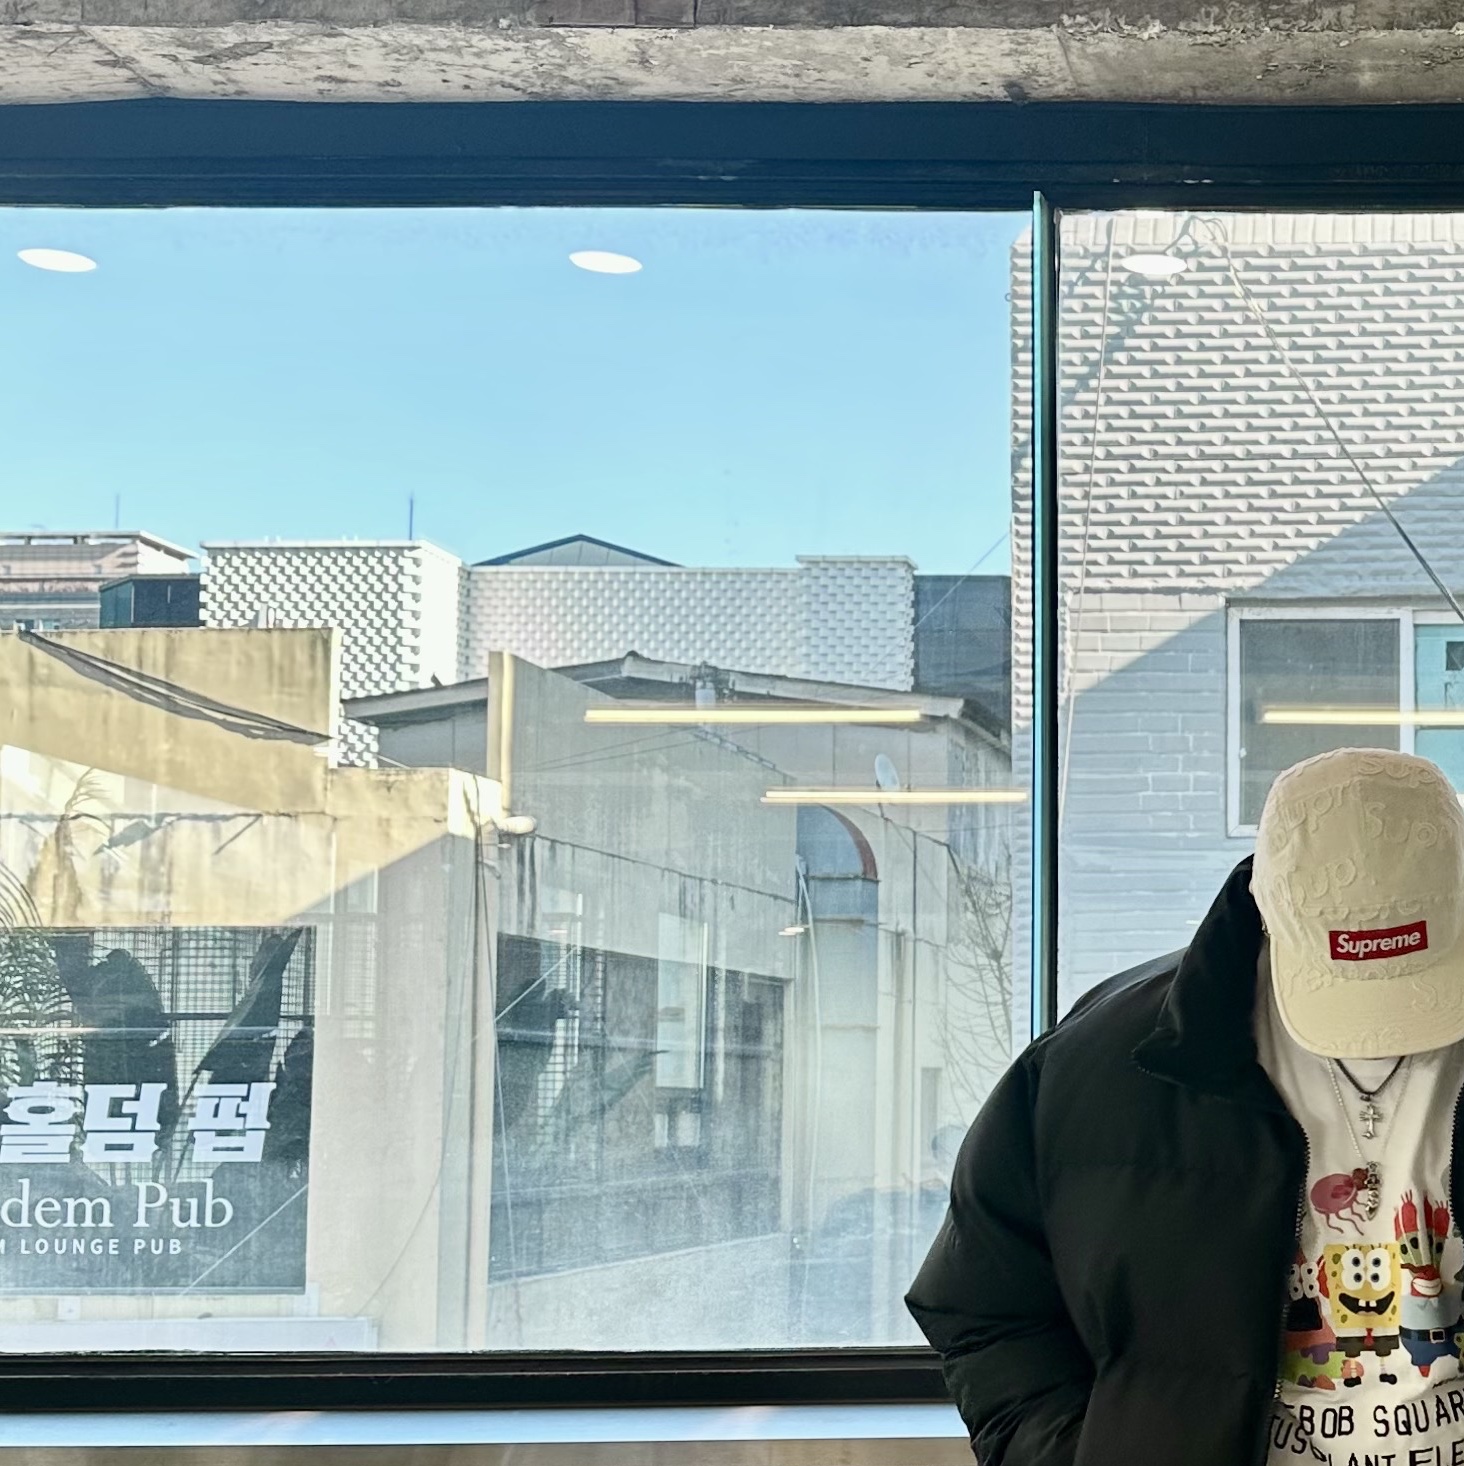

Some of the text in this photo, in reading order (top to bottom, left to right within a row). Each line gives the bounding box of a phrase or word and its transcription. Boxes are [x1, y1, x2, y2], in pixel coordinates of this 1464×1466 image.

[1337, 931, 1421, 958] Supreme
[0, 1081, 277, 1163] 홀덤 펍
[132, 1179, 234, 1228] Pub
[20, 1238, 120, 1255] LOUNGE
[133, 1238, 183, 1255] PUB
[1284, 1404, 1355, 1438] BOB
